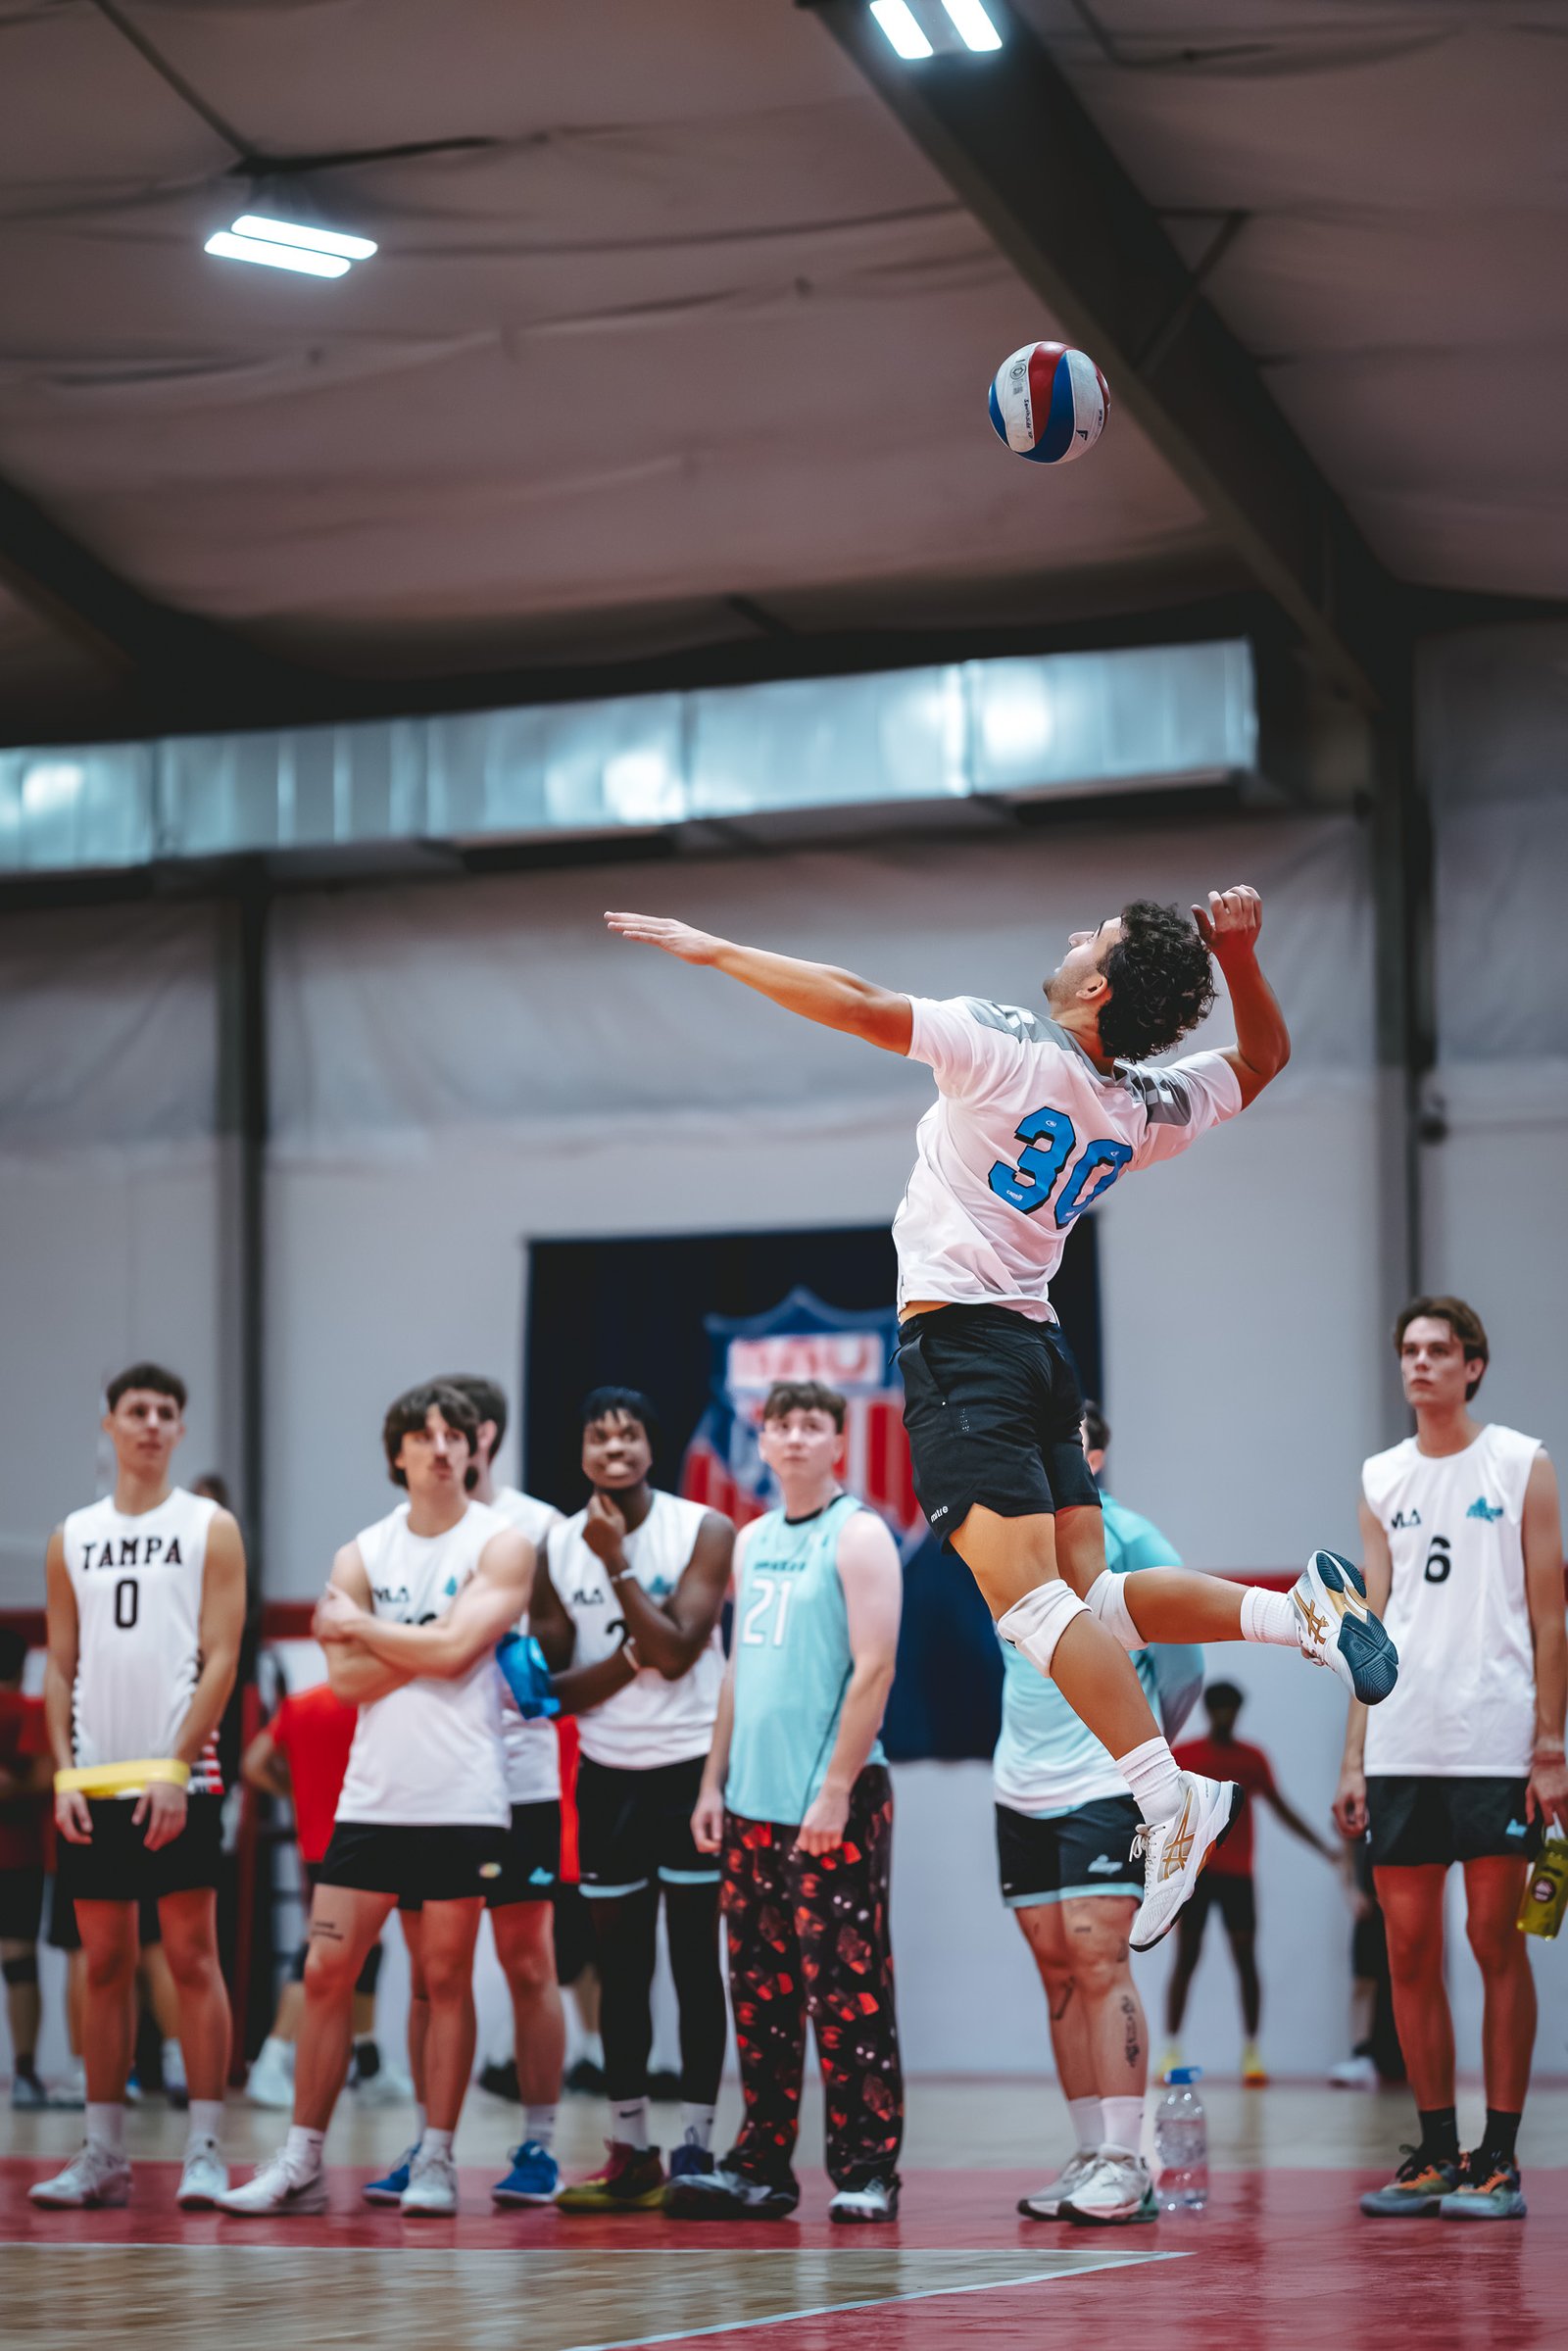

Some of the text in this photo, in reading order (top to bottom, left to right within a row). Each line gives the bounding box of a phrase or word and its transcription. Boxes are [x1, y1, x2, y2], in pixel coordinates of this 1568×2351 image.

[988, 1105, 1134, 1231] 30
[82, 1536, 182, 1570] TAMPA
[1424, 1534, 1451, 1584] 6
[116, 1578, 139, 1629] 0
[742, 1578, 794, 1647] 21
